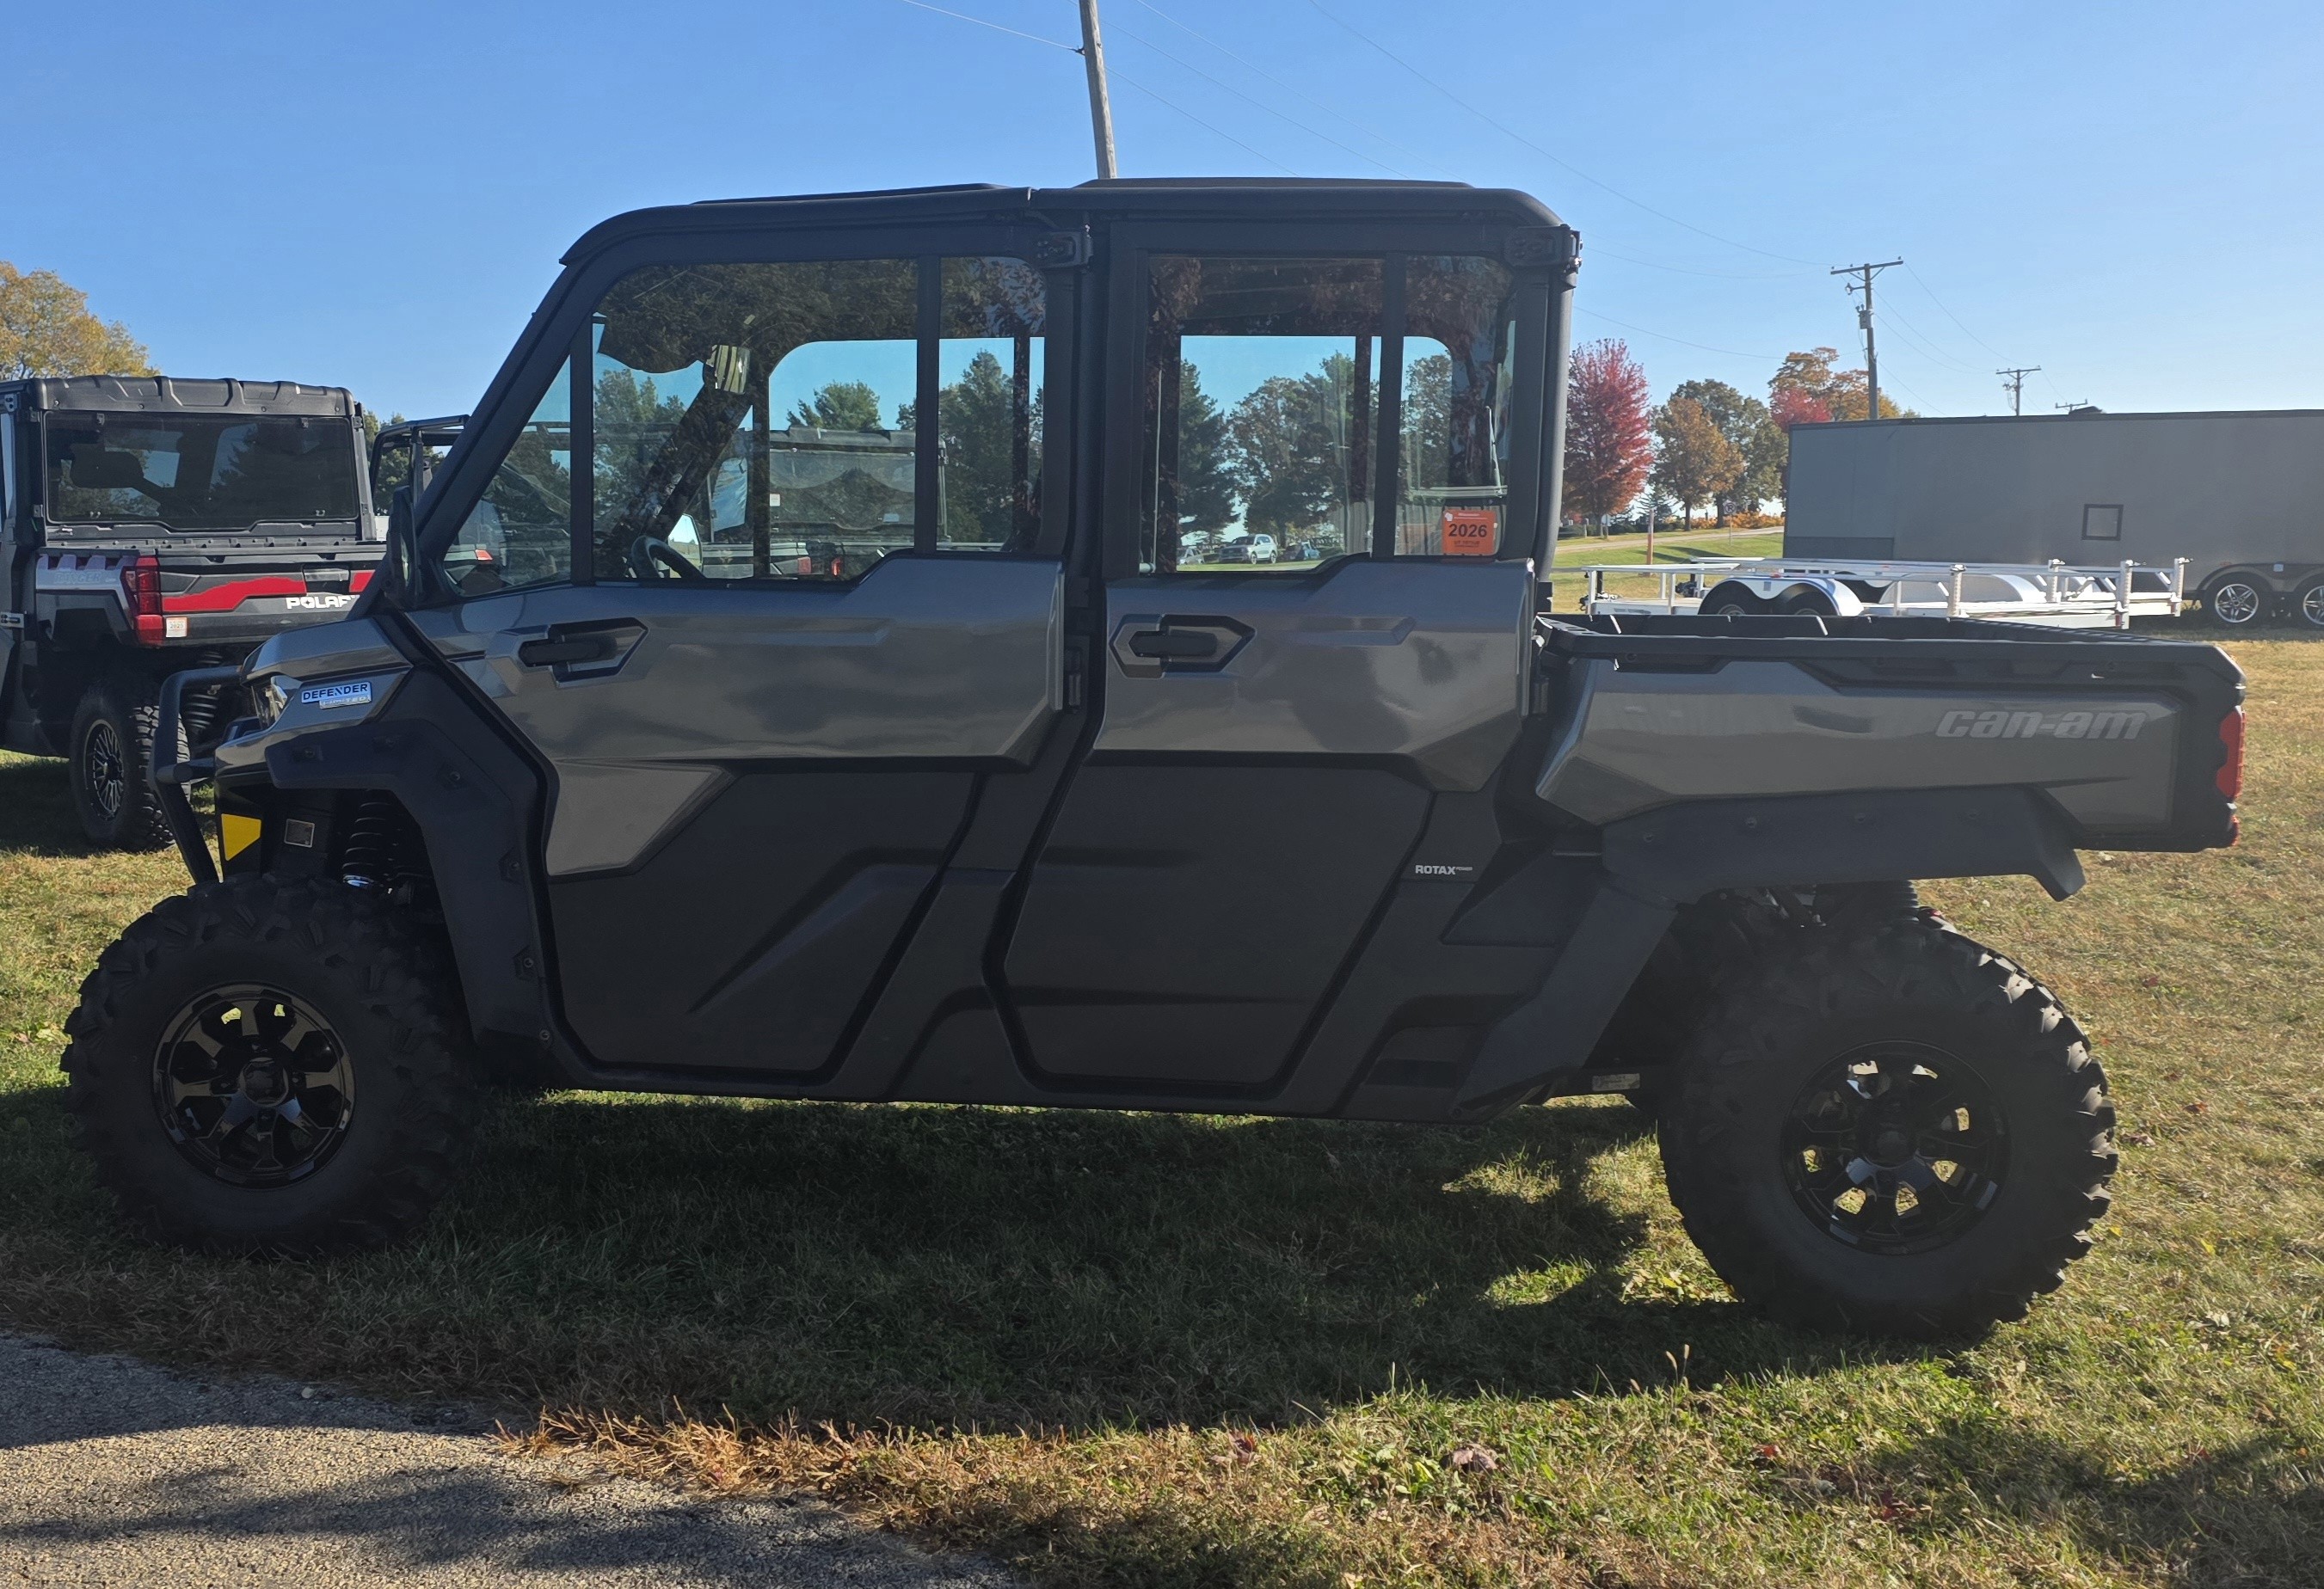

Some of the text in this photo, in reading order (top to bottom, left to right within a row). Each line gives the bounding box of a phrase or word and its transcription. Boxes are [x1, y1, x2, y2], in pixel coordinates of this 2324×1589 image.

[1448, 523, 1487, 537] 2026
[303, 684, 368, 700] DEFENDER
[1936, 710, 2147, 739] can-am
[1415, 865, 1456, 875] ROTAX
